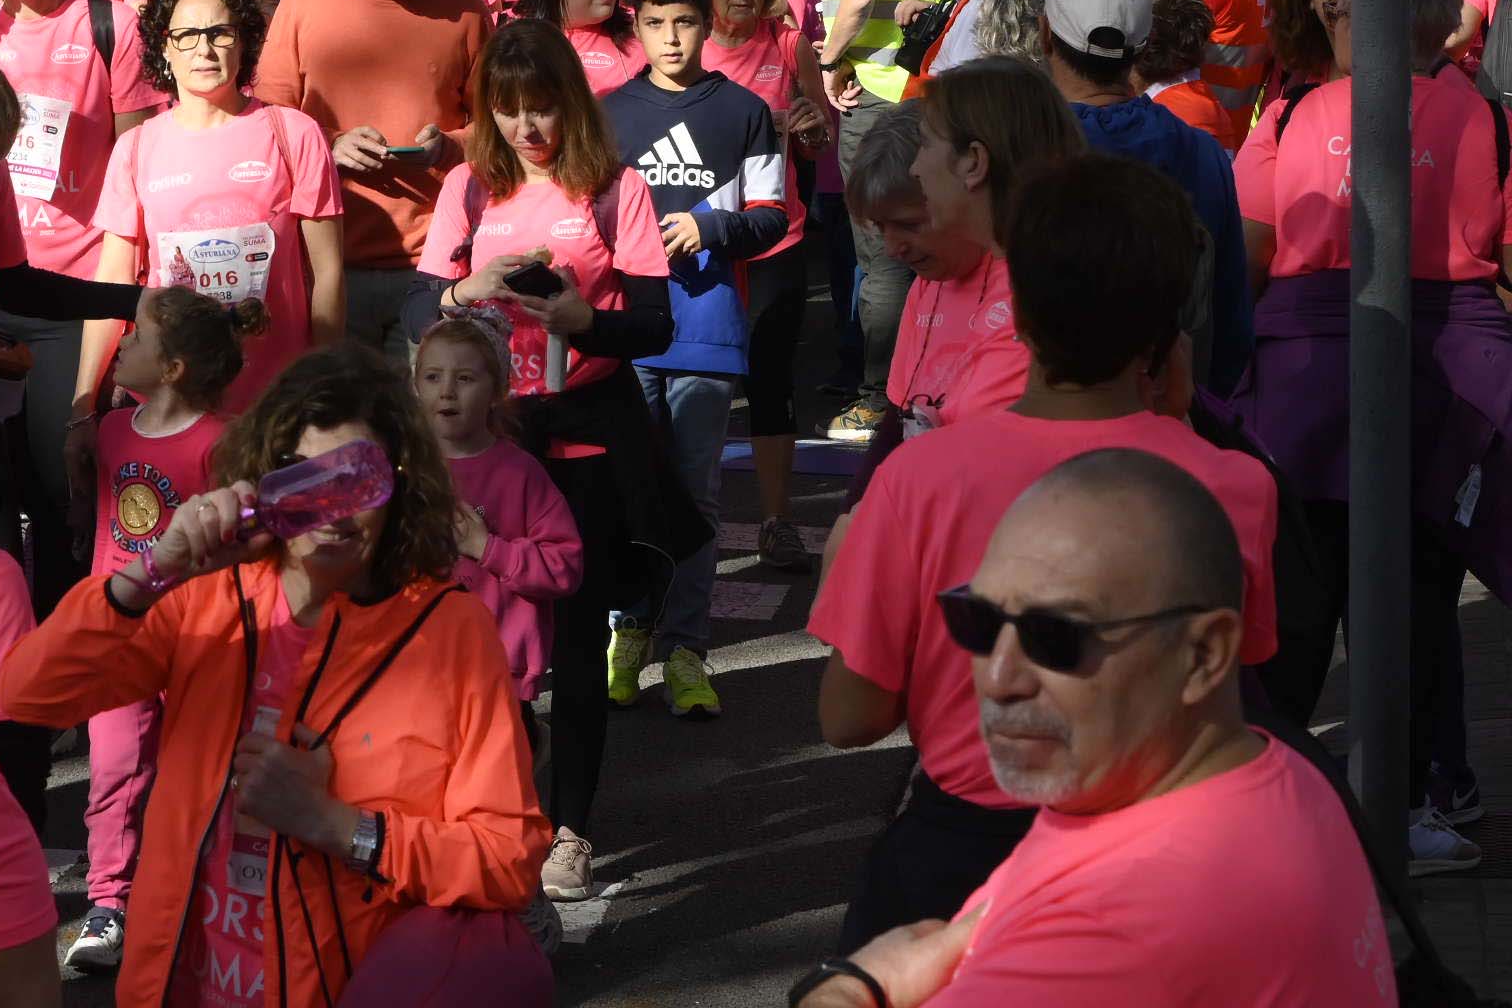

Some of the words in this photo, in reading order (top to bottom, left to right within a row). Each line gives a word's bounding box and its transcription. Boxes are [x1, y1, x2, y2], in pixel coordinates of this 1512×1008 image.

[17, 135, 35, 149] 16
[193, 246, 237, 258] ASTURIANA
[200, 270, 238, 288] 016
